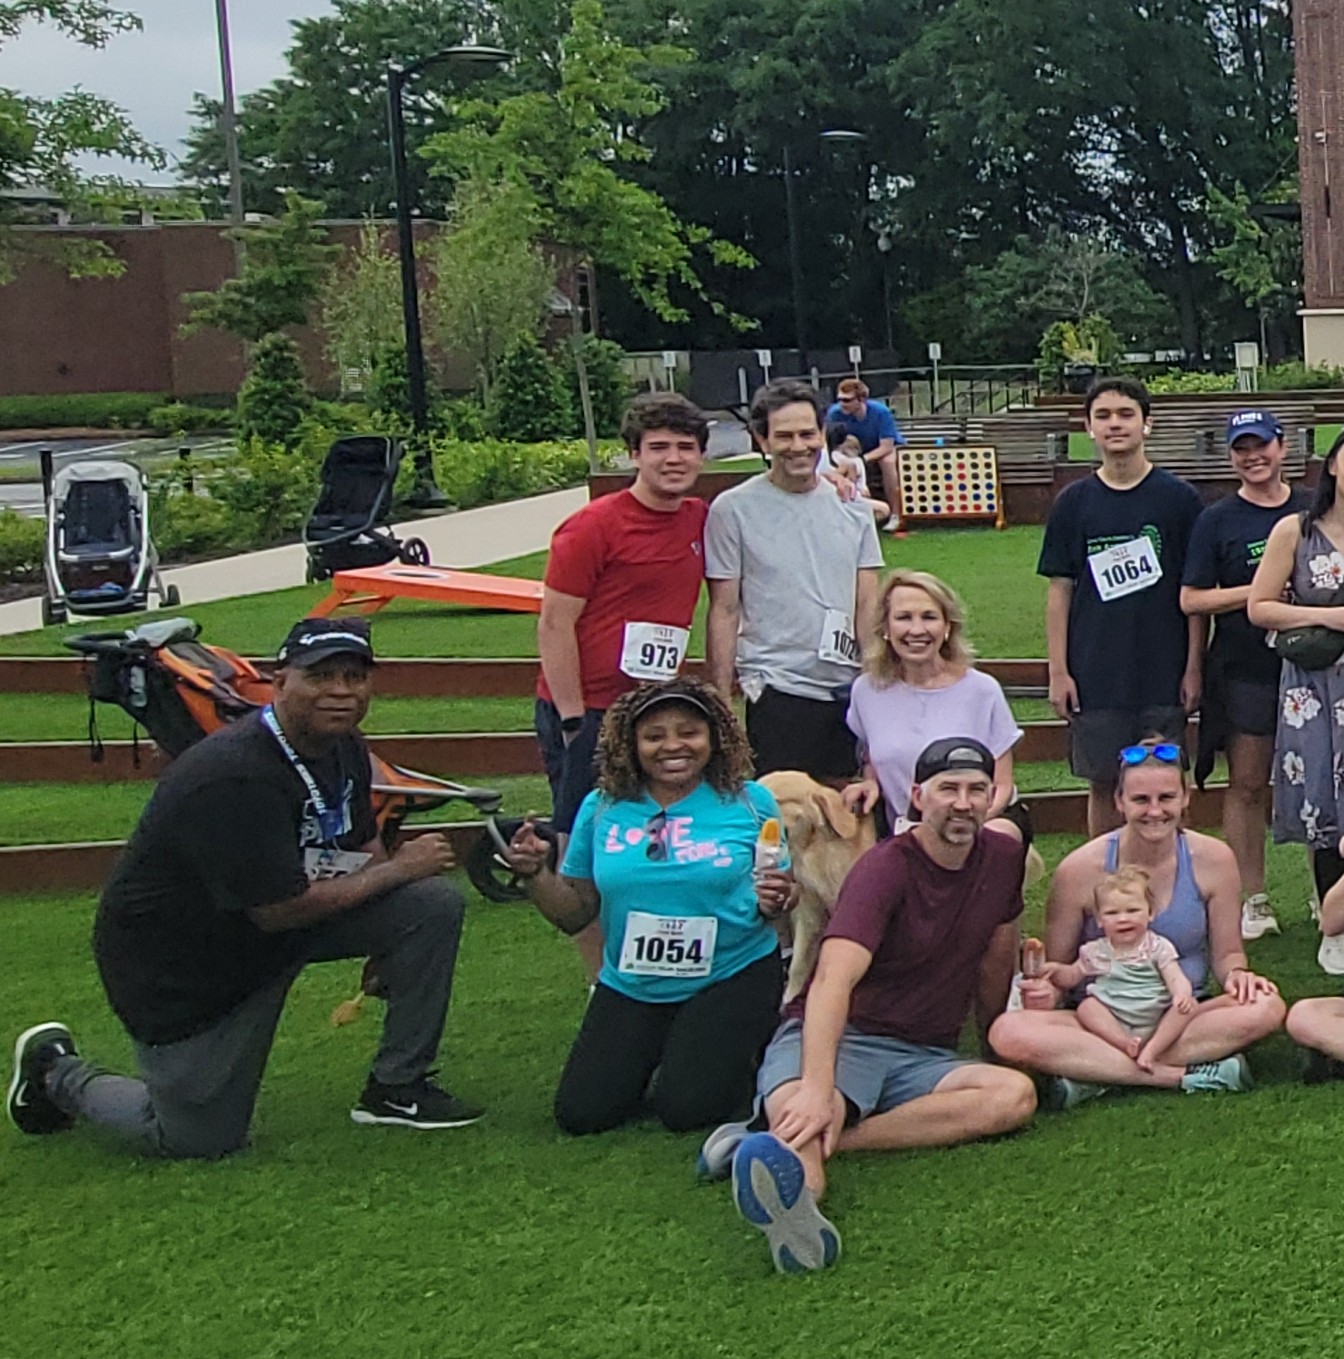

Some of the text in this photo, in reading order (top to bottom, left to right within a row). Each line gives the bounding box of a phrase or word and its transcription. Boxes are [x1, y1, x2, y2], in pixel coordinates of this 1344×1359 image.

[1101, 554, 1152, 588] 1064
[640, 643, 678, 669] 973
[605, 817, 694, 853] LOE
[634, 935, 703, 964] 1054
